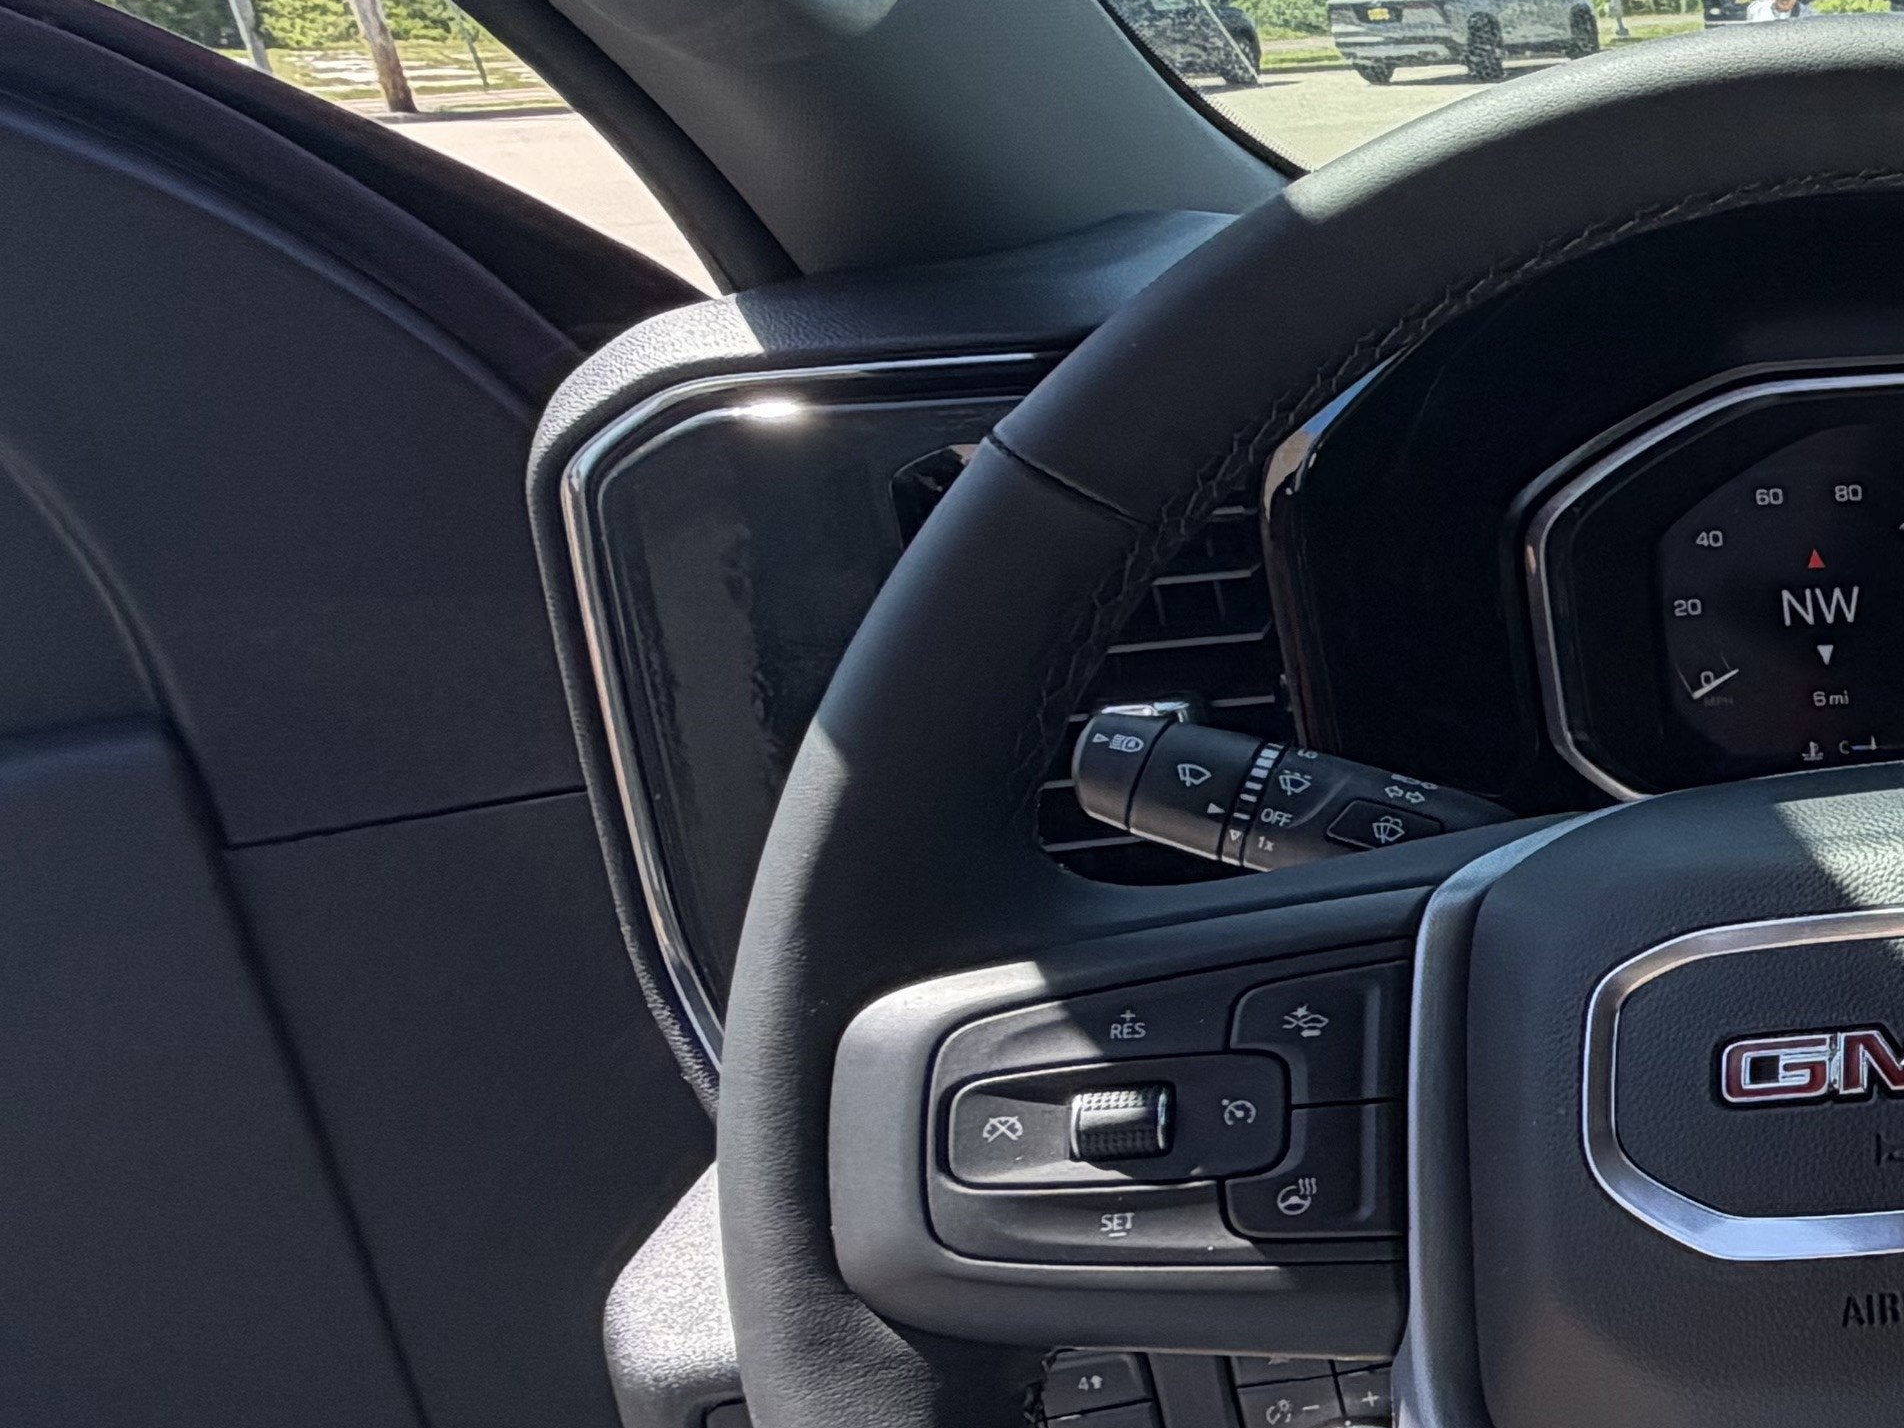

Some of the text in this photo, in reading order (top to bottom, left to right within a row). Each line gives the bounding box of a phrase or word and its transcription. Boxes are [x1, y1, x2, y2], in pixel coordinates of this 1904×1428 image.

[1755, 488, 1784, 506] 60
[1834, 484, 1863, 503] 80
[1695, 530, 1724, 548] 40
[1673, 598, 1702, 617] 20
[1780, 585, 1860, 627] NW
[1700, 671, 1715, 687] 0
[1812, 689, 1850, 707] 6 mi
[1838, 739, 1850, 755] C
[1260, 808, 1293, 827] OFF
[1257, 835, 1274, 852] 1x
[1109, 1020, 1147, 1040] RES
[1100, 1212, 1135, 1233] SET
